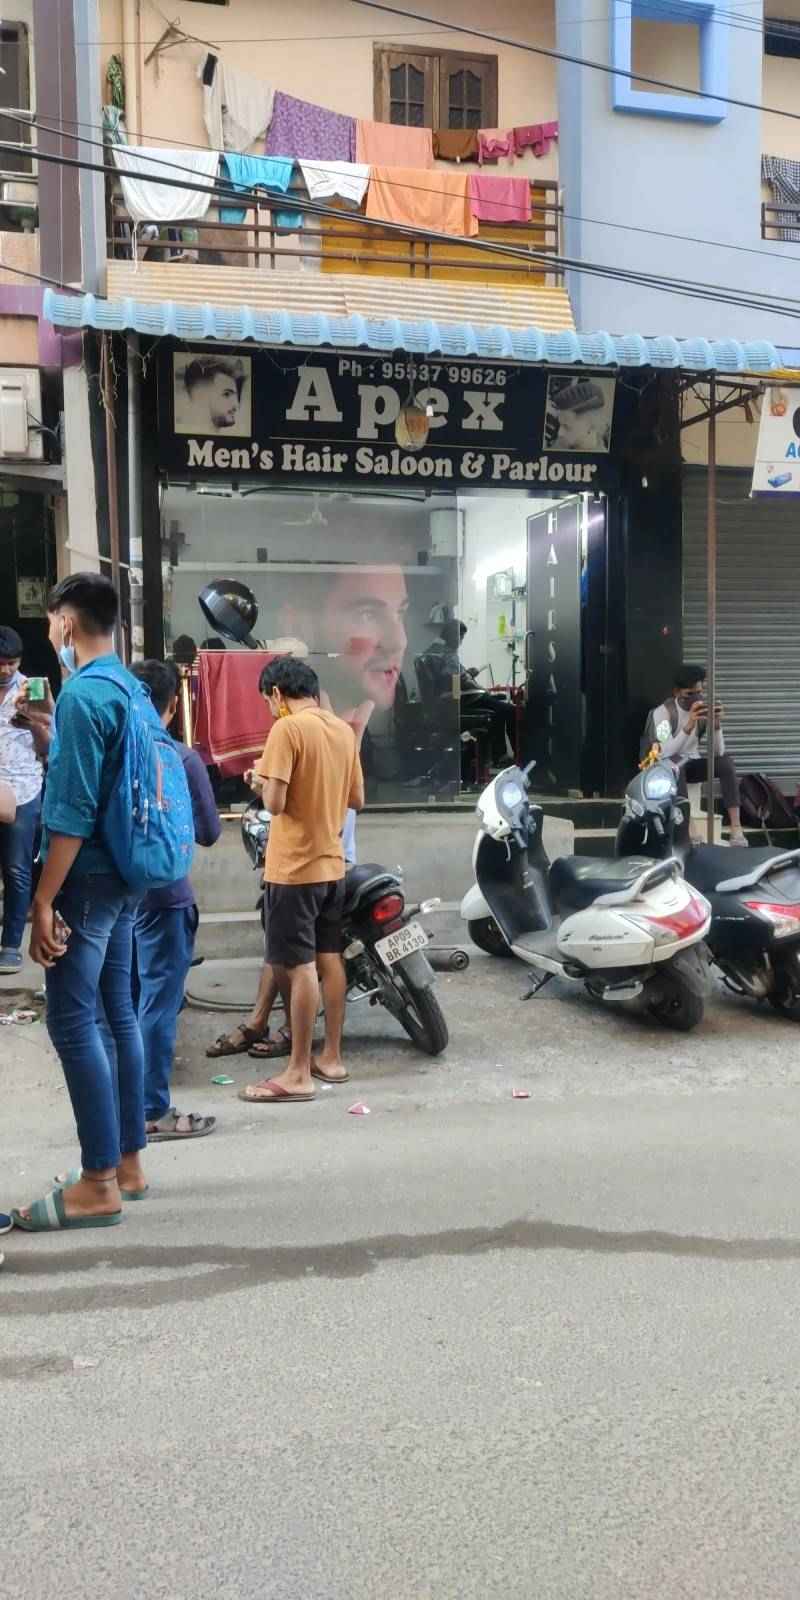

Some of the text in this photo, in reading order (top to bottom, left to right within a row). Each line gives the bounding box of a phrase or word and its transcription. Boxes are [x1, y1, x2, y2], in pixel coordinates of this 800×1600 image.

[338, 359, 361, 377] Ph
[382, 361, 441, 381] 95537
[449, 366, 507, 386] 99626
[285, 366, 506, 439] Apex
[187, 439, 597, 482] Men's Hair Saloon & Parlour
[387, 928, 411, 949] AP09
[385, 948, 401, 961] BR
